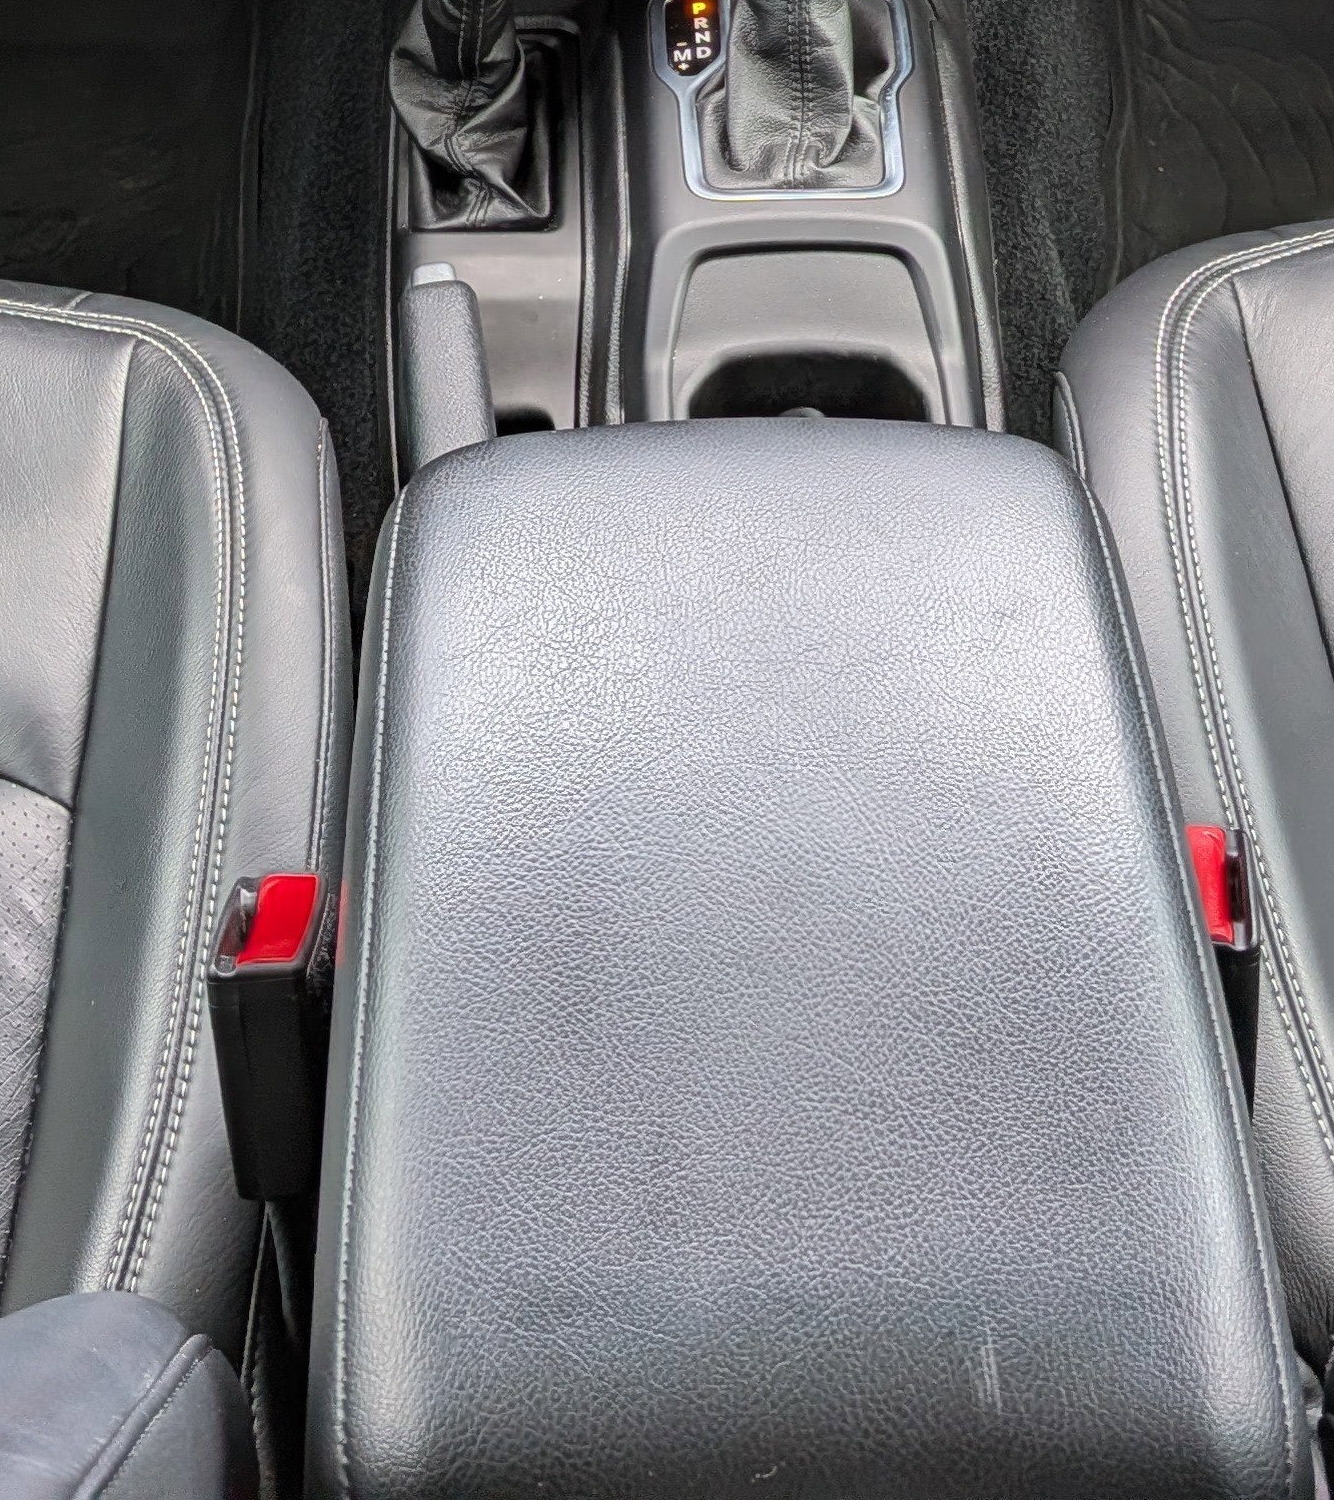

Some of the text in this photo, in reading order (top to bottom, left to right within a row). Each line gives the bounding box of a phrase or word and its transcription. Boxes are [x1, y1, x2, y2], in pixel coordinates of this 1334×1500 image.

[692, 2, 706, 15] P
[693, 16, 709, 29] R
[695, 30, 711, 44] N
[673, 46, 712, 62] M D
